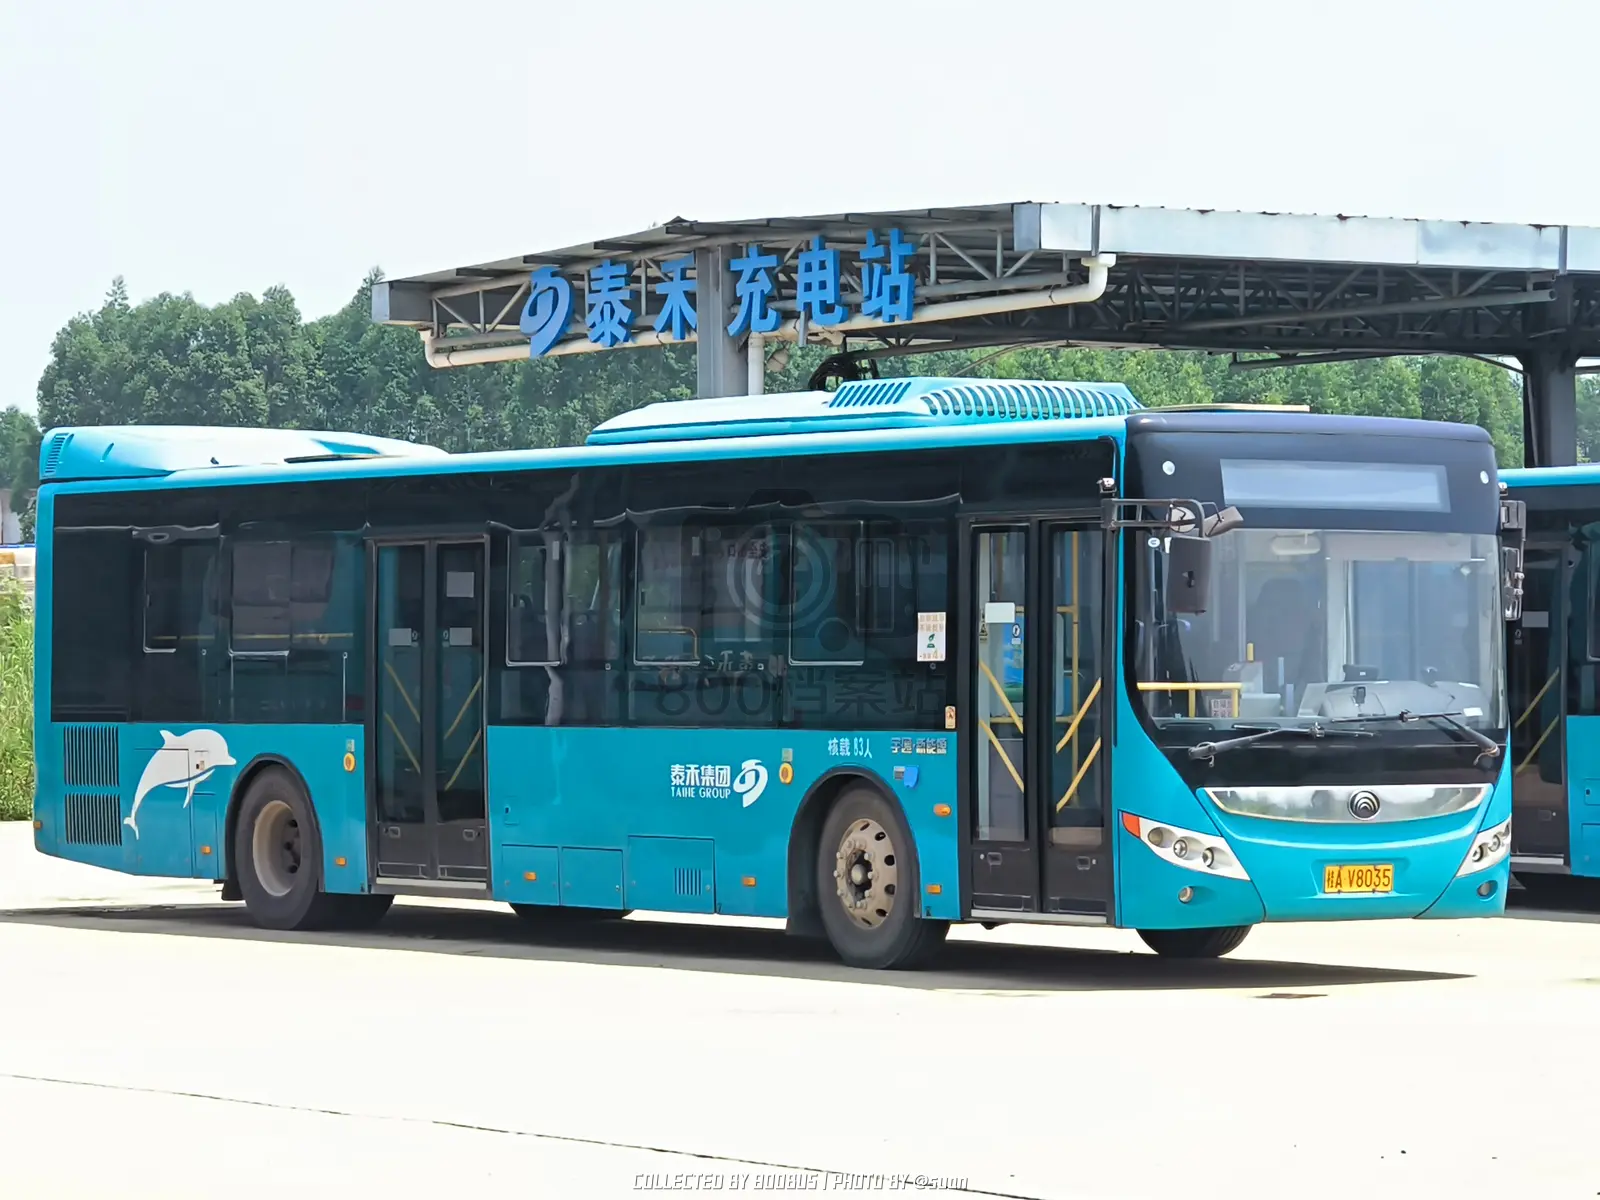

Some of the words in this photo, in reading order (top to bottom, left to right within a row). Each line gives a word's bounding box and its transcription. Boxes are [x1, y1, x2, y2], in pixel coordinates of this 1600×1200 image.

[585, 228, 916, 347] 泰禾充电站
[670, 764, 731, 787] 泰禾集团
[671, 786, 696, 798] TAIHE
[699, 787, 731, 799] GROUP
